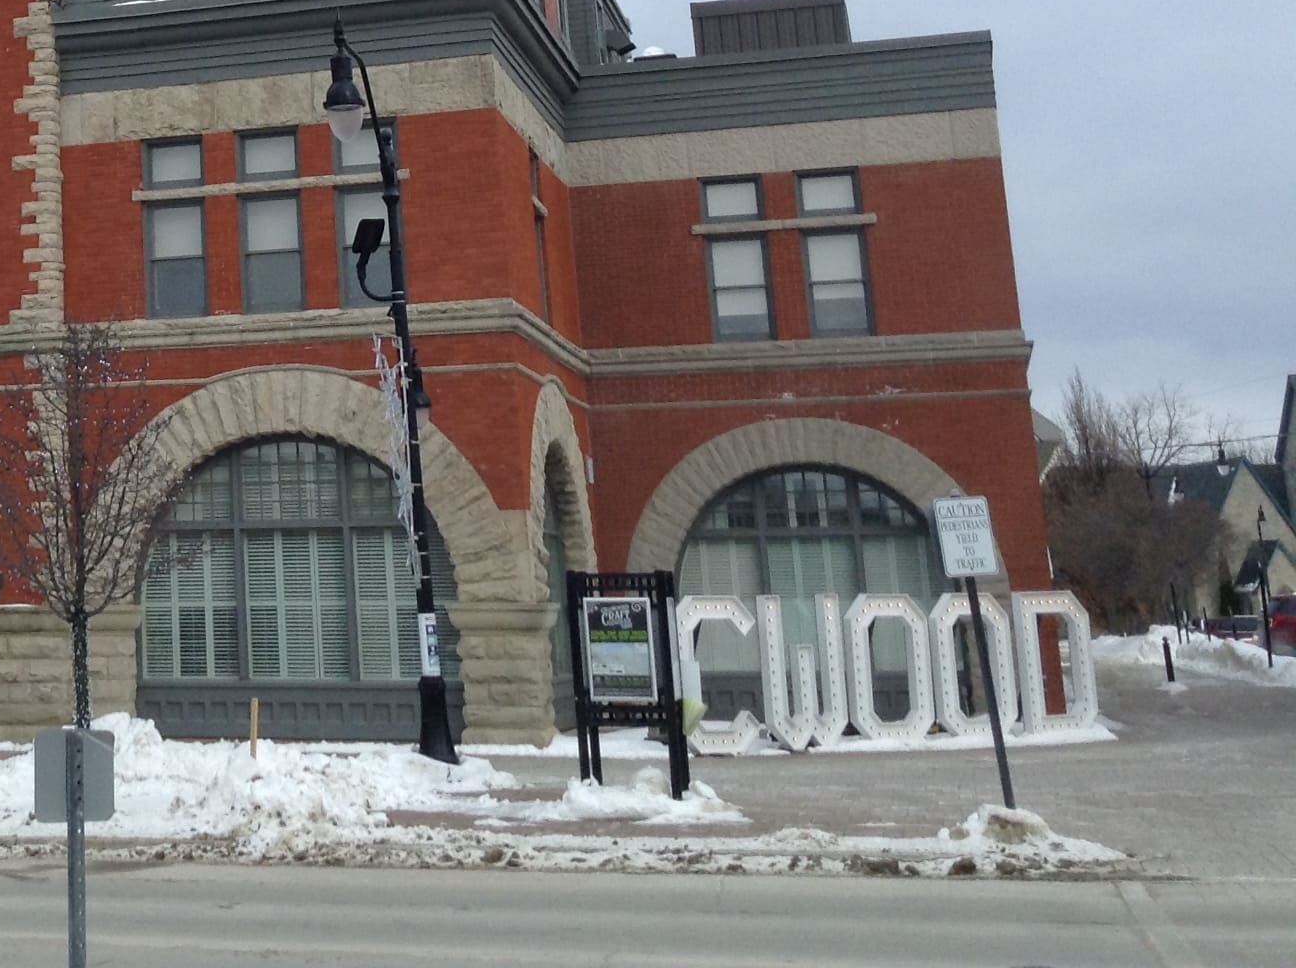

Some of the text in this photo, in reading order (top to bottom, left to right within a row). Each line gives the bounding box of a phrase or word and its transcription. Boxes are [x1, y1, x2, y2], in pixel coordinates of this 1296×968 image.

[937, 502, 985, 517] CAUTION
[955, 533, 979, 544] YIELD
[963, 545, 976, 556] TO
[676, 591, 1098, 755] CWOOD
